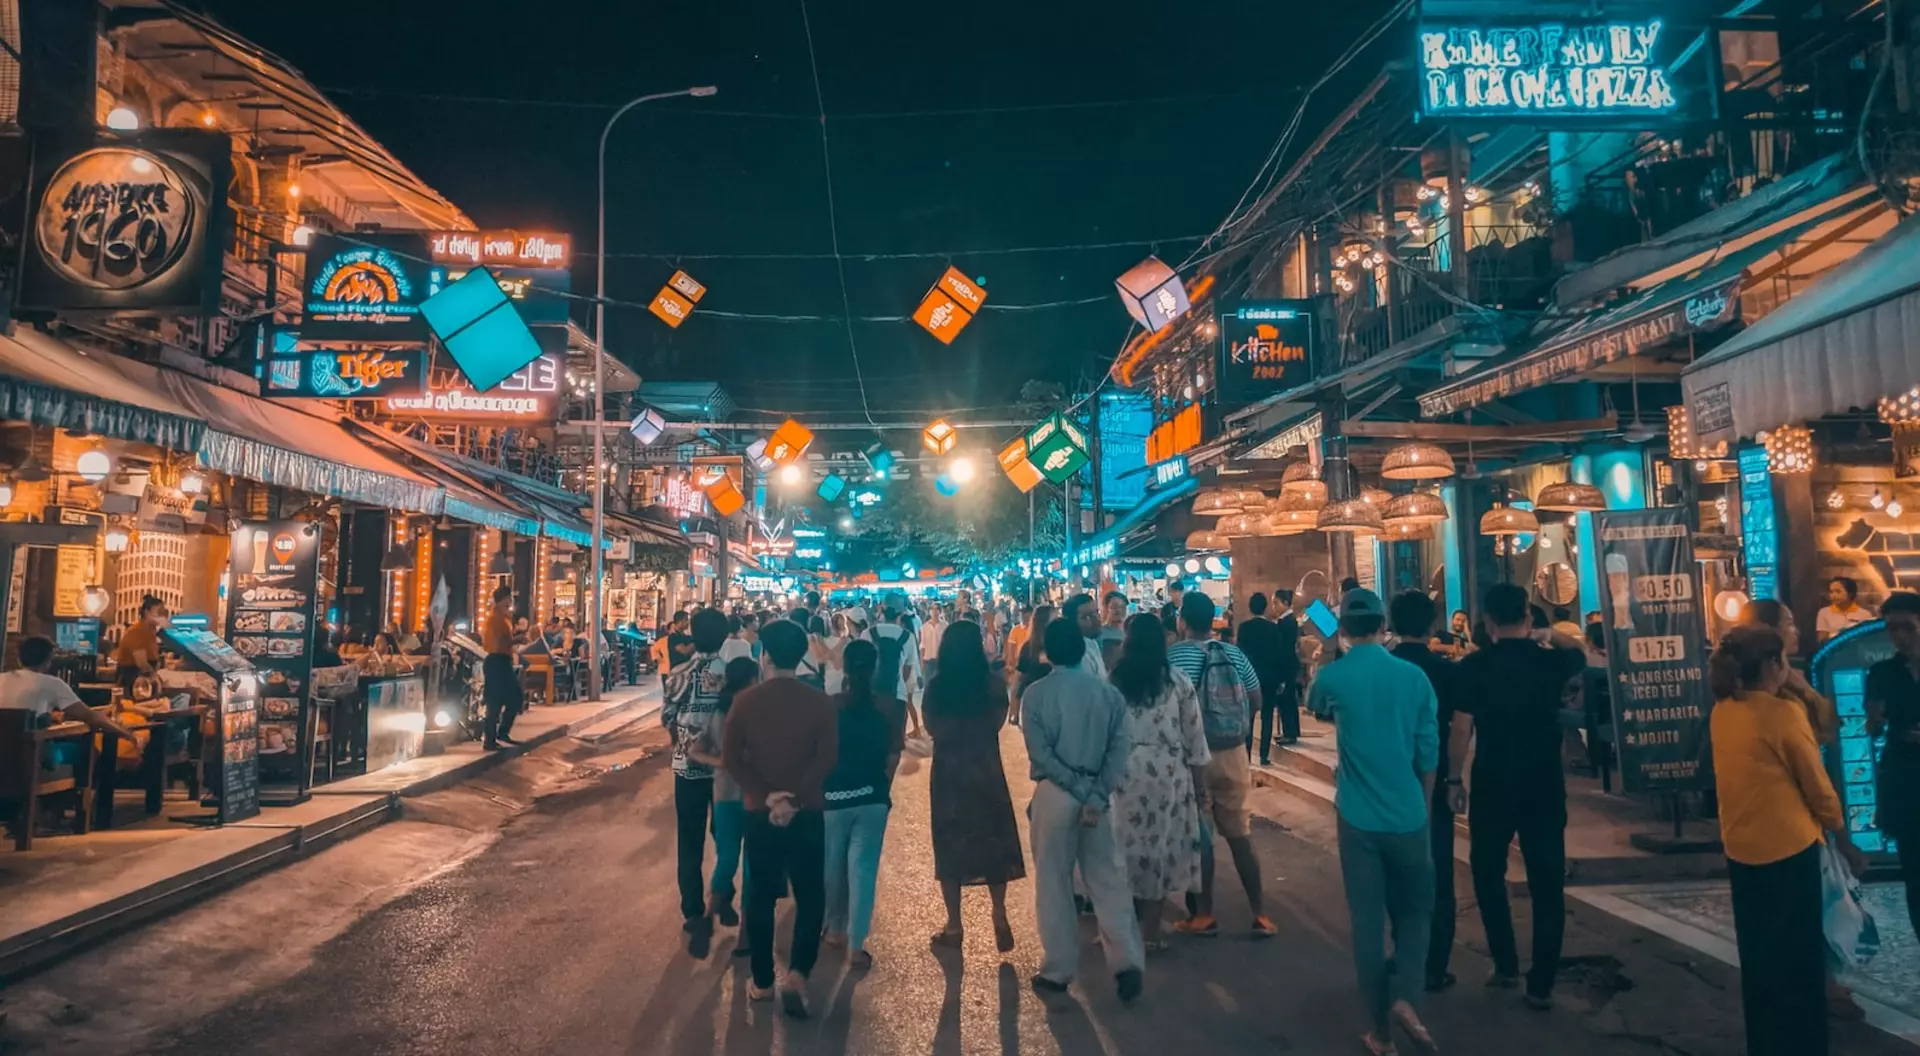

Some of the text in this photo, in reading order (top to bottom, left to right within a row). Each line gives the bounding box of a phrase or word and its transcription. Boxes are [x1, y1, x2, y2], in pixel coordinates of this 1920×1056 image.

[1585, 66, 1676, 109] PIZZA
[337, 352, 409, 387] Tiger
[1638, 578, 1683, 598] $0.50
[1636, 640, 1676, 659] $1.75
[1631, 667, 1702, 685] LONG ISLAND
[1632, 684, 1682, 699] ICED TEA
[1636, 705, 1700, 721] MARGARITA
[1638, 730, 1679, 745] MOJITO
